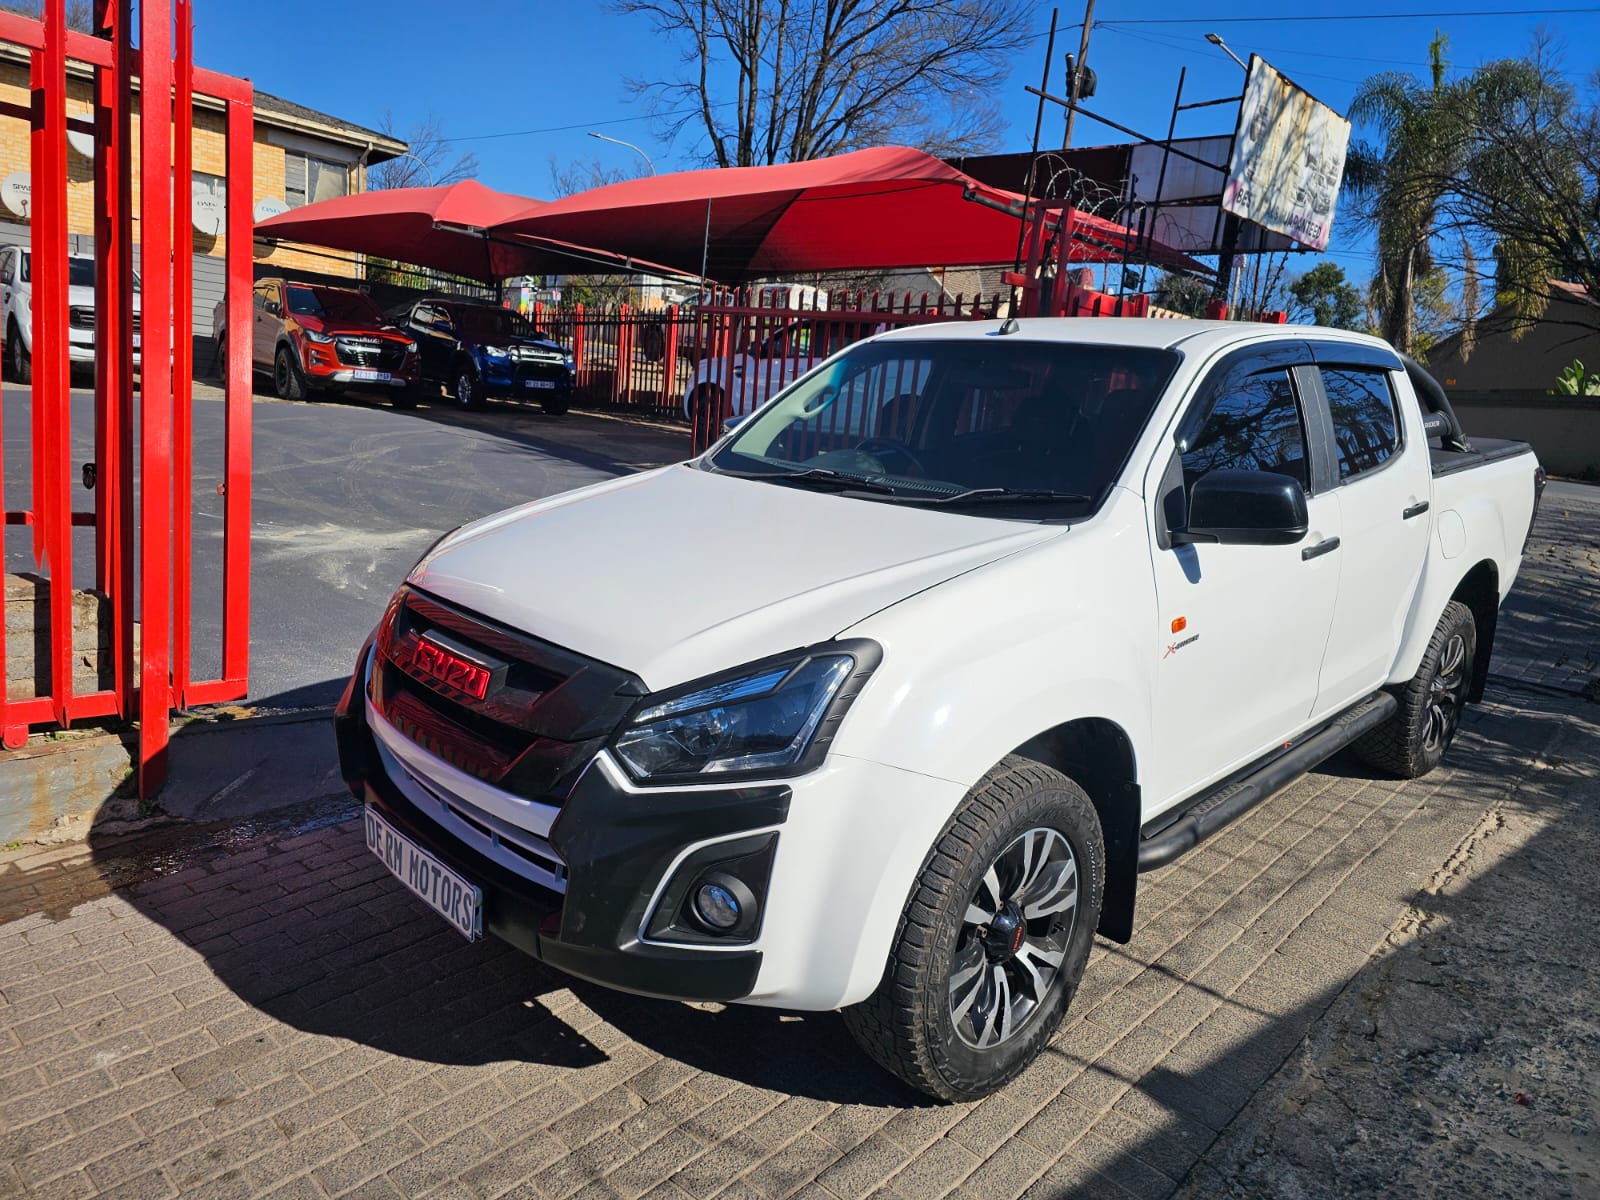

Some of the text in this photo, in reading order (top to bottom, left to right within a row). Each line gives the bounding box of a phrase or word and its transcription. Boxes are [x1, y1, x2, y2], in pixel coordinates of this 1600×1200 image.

[412, 640, 489, 700] ISUZU
[366, 812, 472, 931] DE RM MOTORS
